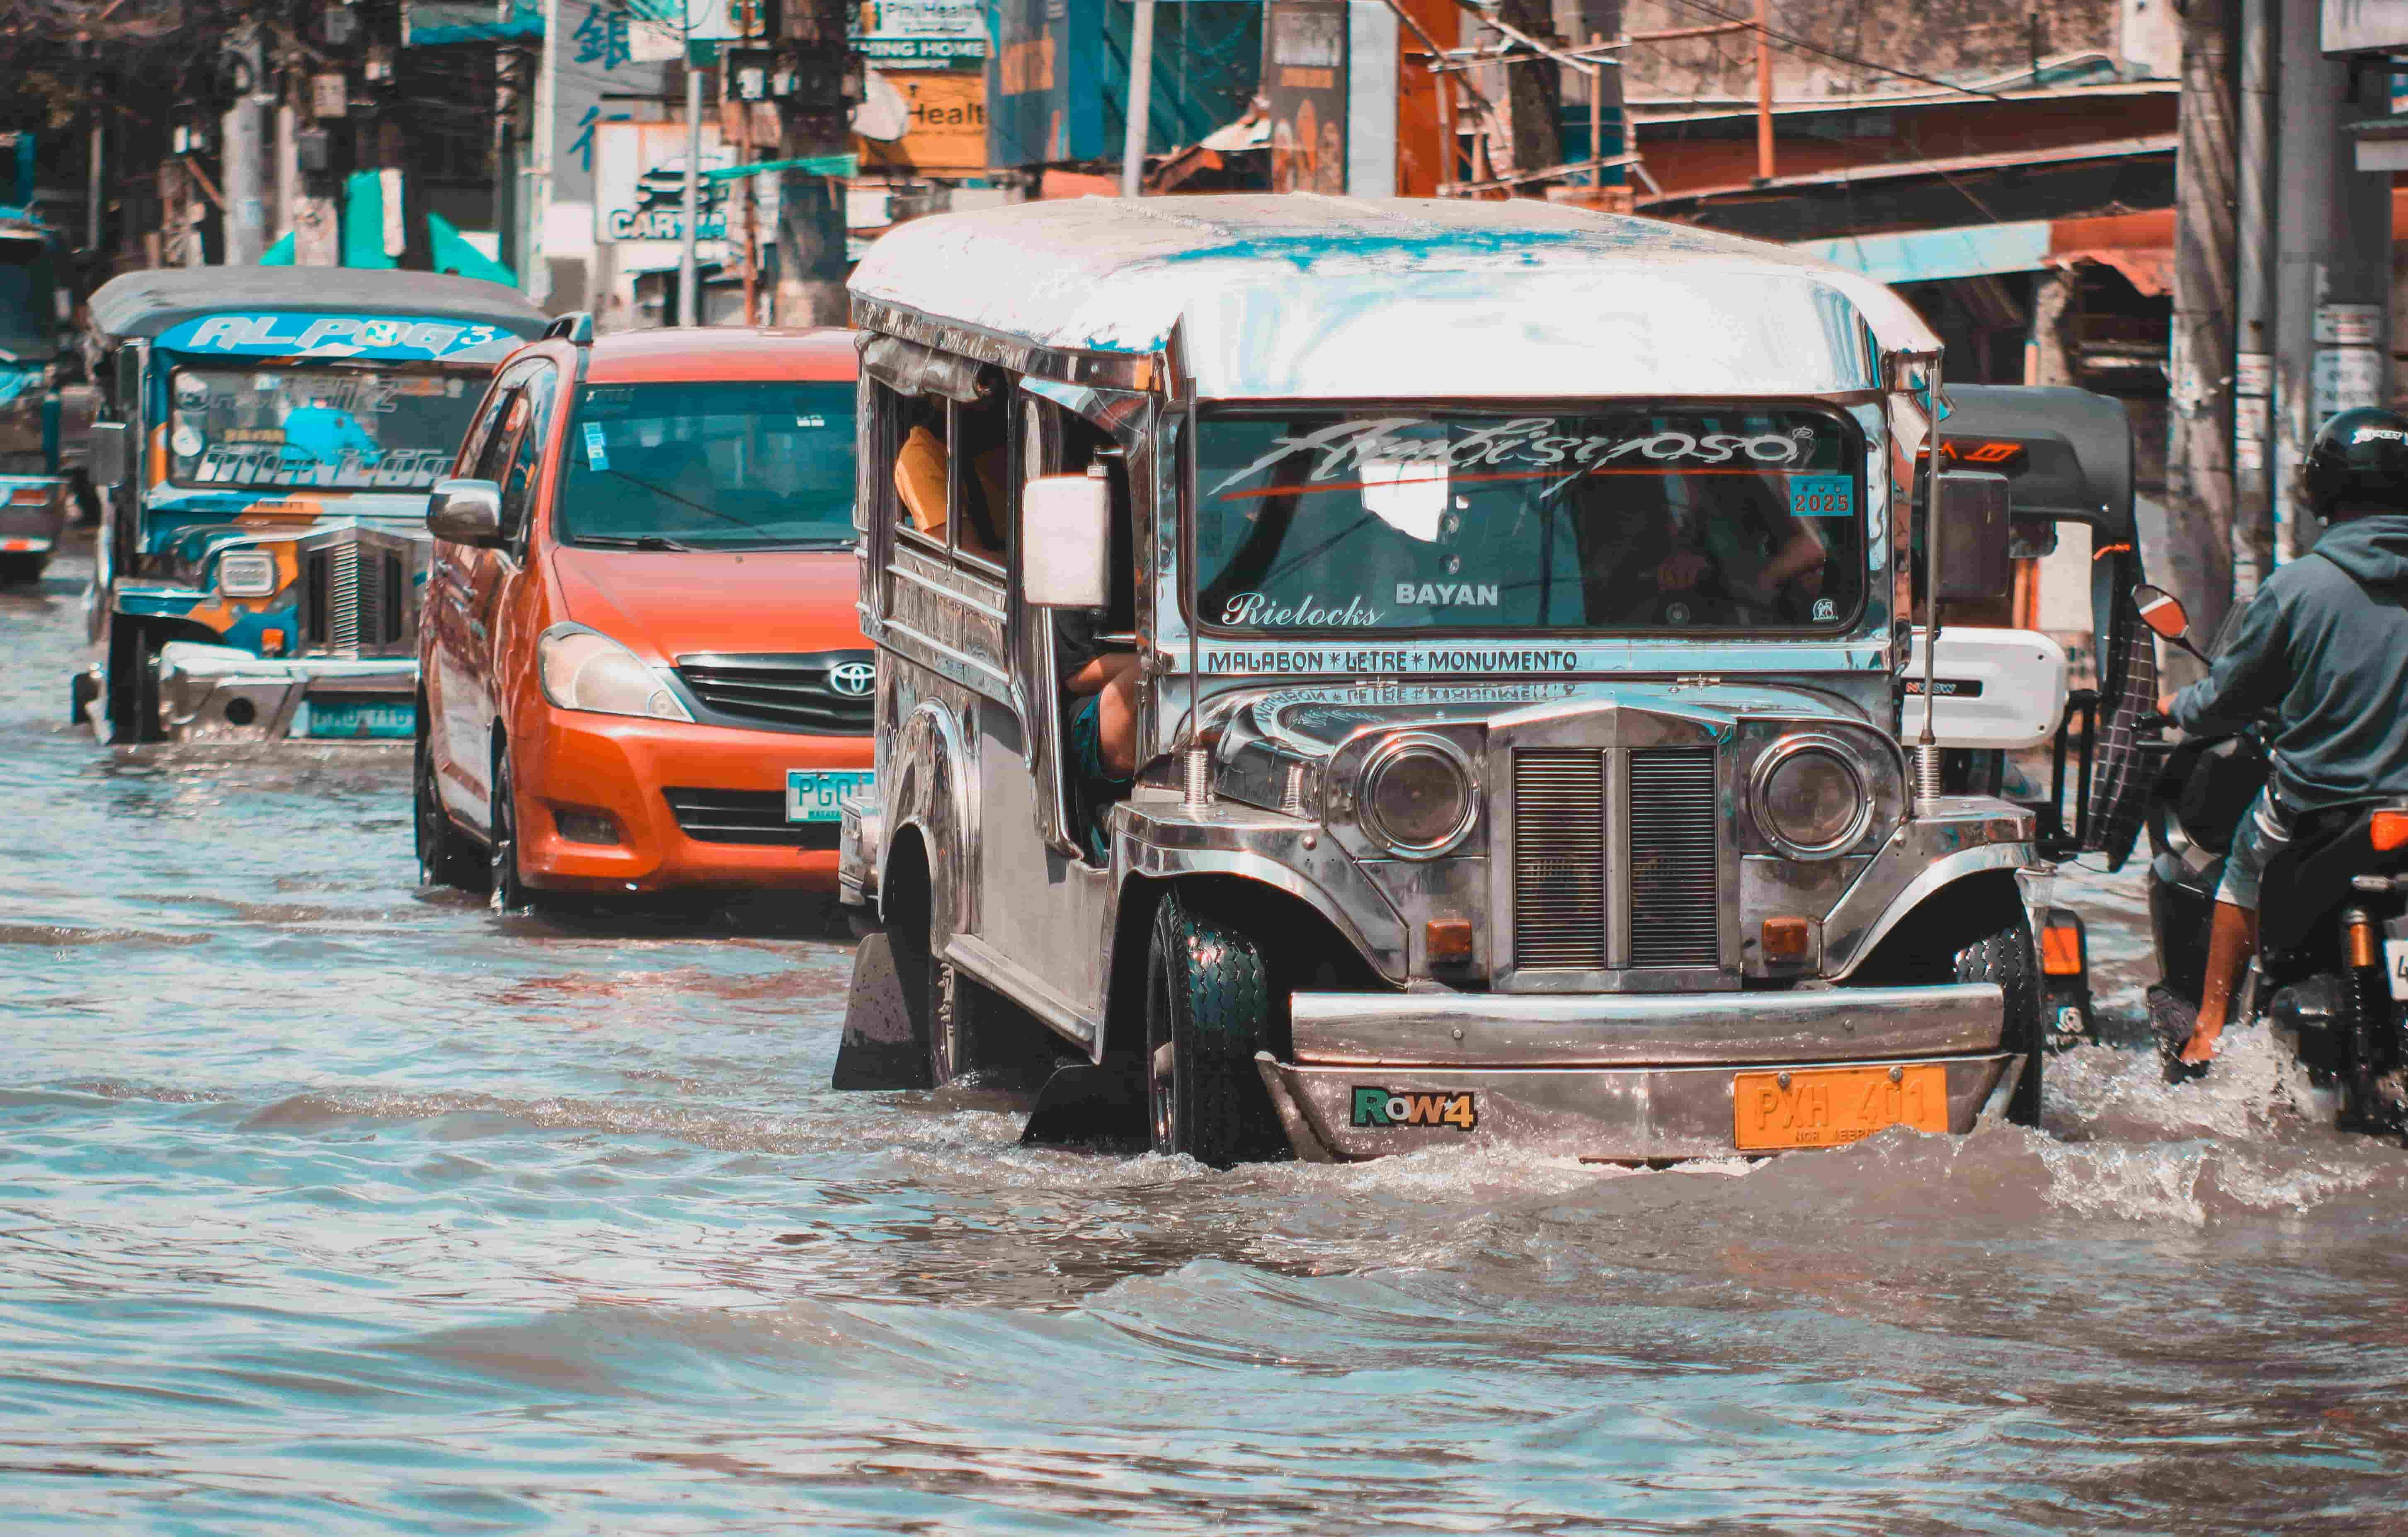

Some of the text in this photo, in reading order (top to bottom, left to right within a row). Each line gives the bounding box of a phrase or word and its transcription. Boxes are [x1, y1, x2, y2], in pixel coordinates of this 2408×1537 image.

[919, 43, 986, 57] HOME
[1795, 495, 1848, 511] 2025
[1396, 583, 1498, 606] BAYAN
[1221, 592, 1386, 626] Rielocks
[1208, 651, 1577, 673] MALABON LETRE MONUMENTO
[1757, 1083, 1829, 1130] PXH
